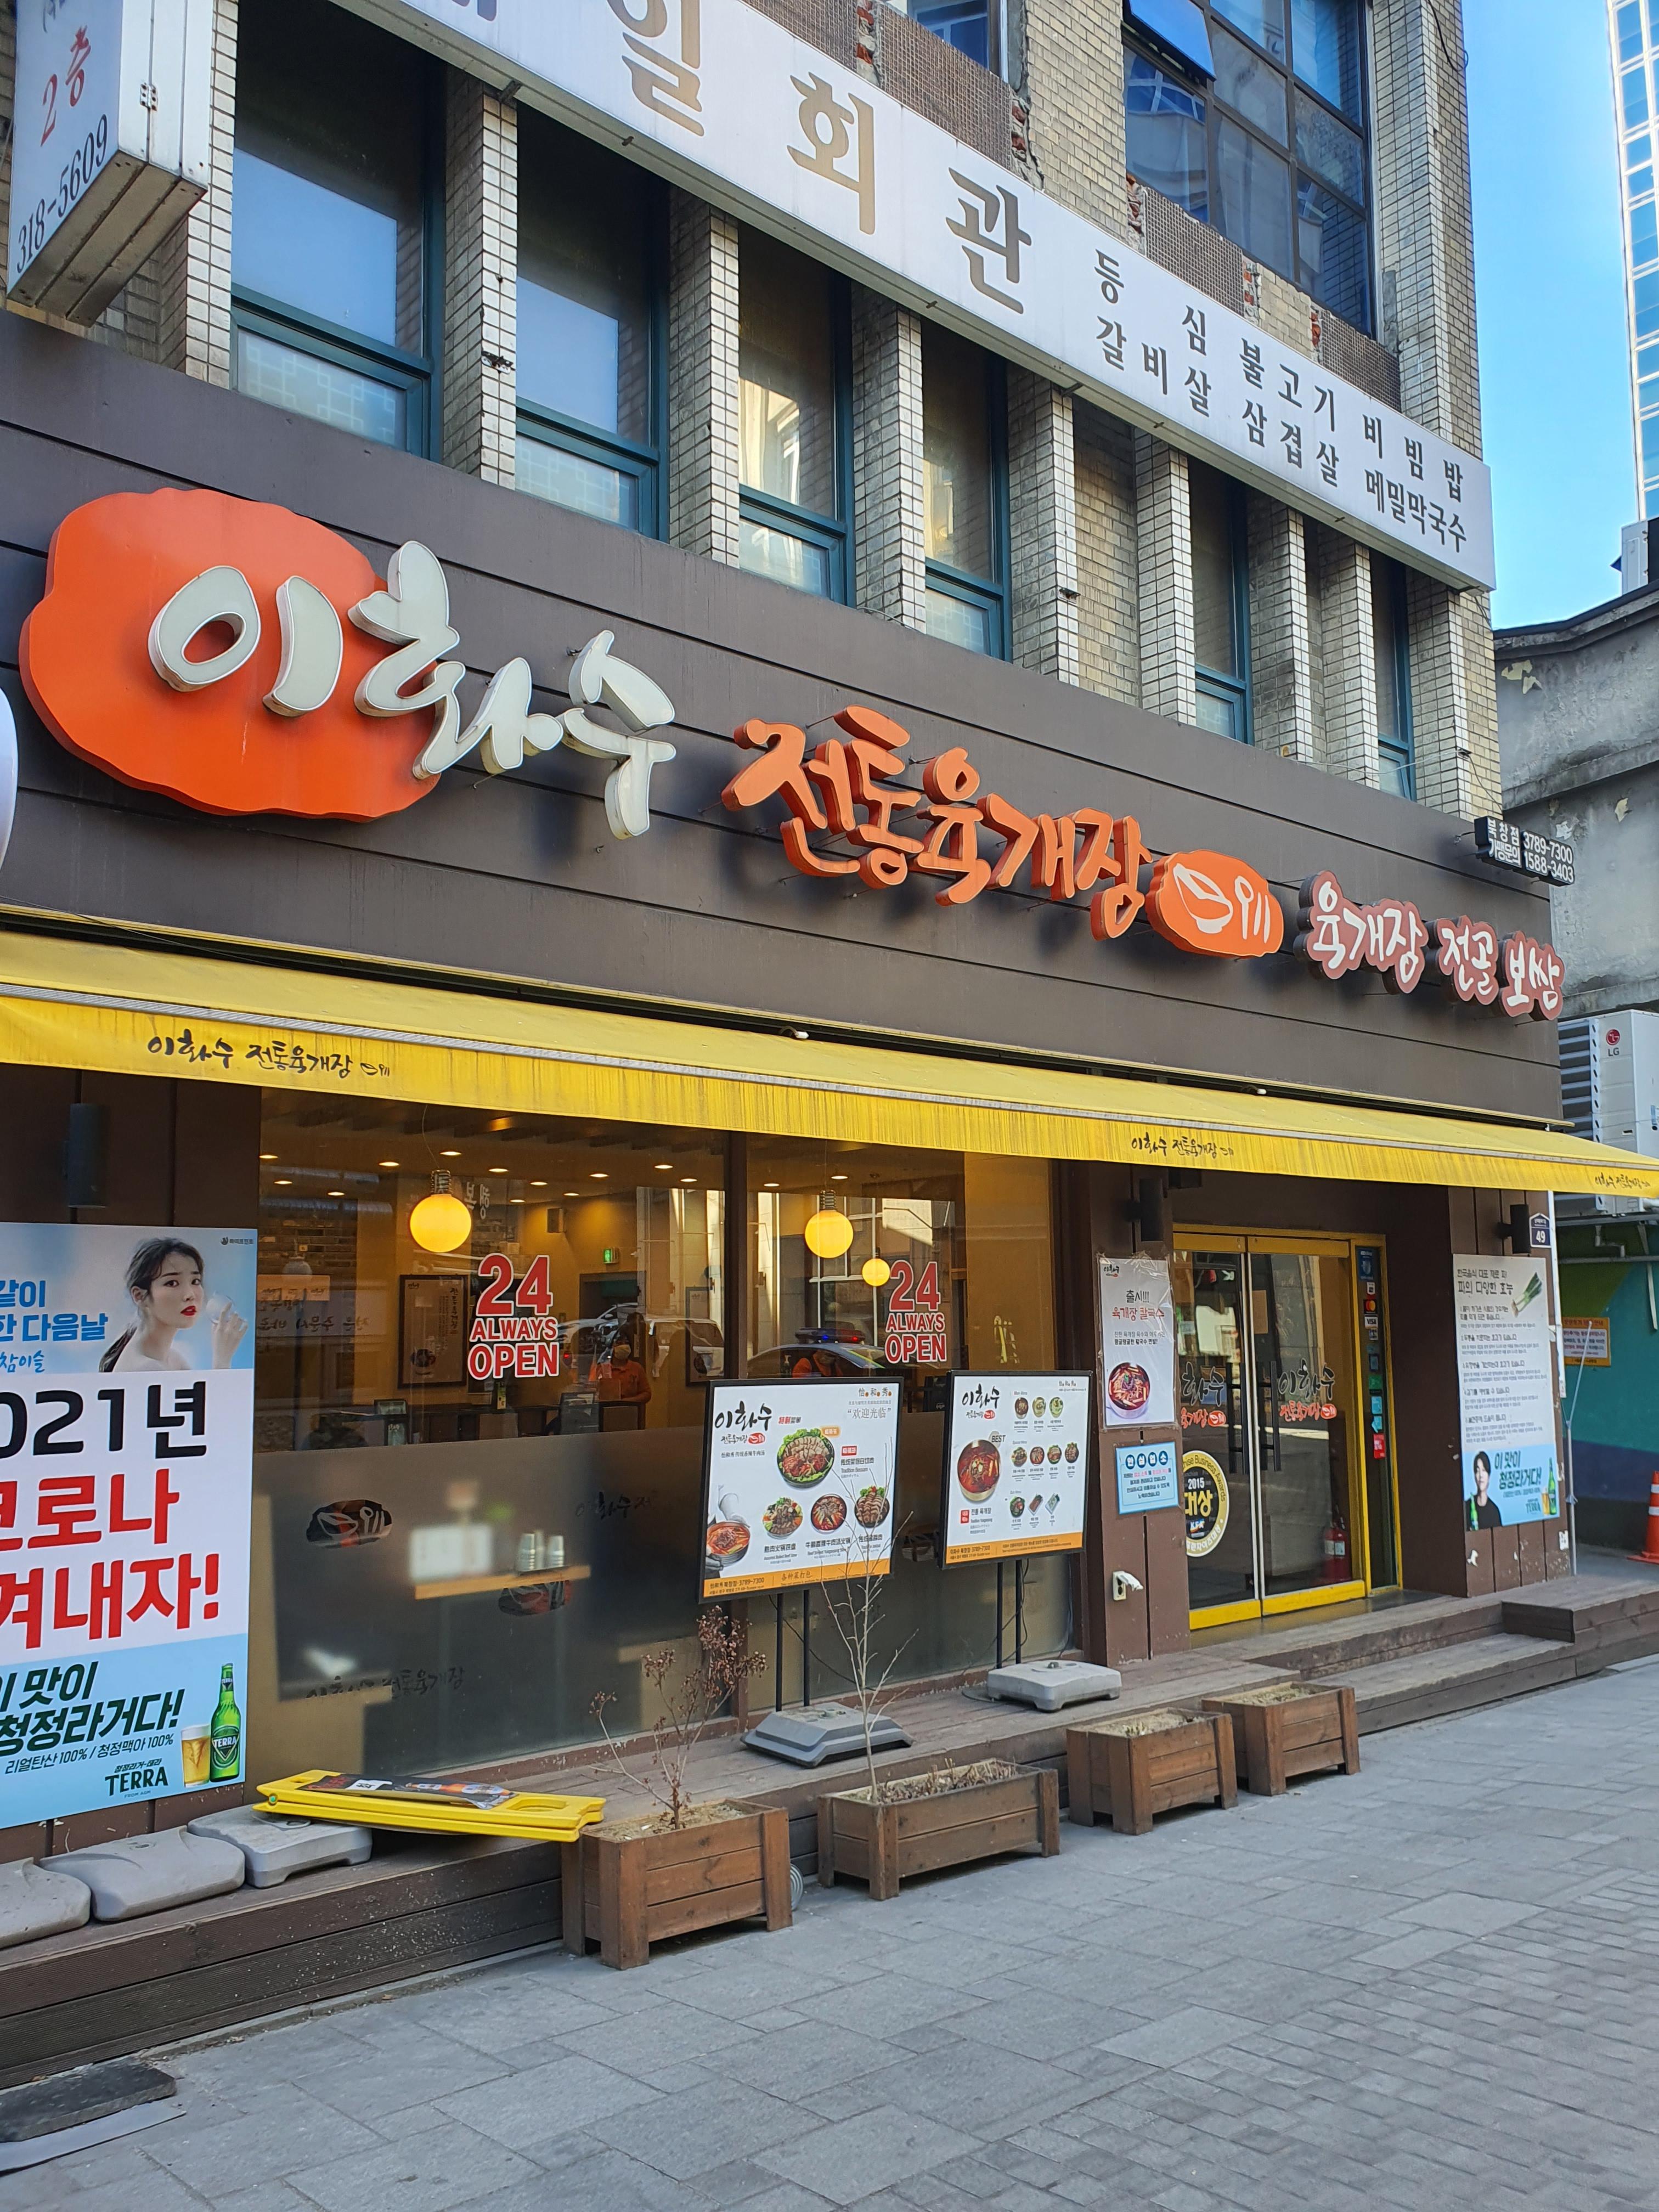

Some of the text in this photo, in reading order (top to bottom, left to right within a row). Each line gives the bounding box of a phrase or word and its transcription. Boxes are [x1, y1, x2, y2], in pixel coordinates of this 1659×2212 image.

[40, 25, 91, 147] 2층
[450, 0, 1031, 314] 일회관
[16, 114, 108, 274] 318-5609
[1096, 316, 1466, 553] 갈비살 삼겹살 메밀막국수
[1239, 338, 1336, 432] 불고기
[1363, 414, 1464, 503] 비빔밥
[148, 540, 1153, 941] 이화수 전통육개장
[1488, 818, 1572, 864] 북창점 3789-7300
[1489, 838, 1573, 882] 가맹문의 1588-3403
[1313, 881, 1423, 983] 육개장
[1442, 925, 1494, 995] 전골
[148, 1029, 353, 1079] 이화수 전통육개장
[1608, 1047, 1620, 1057] LG
[1132, 1132, 1217, 1159] 이화수 전통육개장
[1536, 1231, 1545, 1243] 49
[477, 1252, 554, 1317] 24
[889, 1260, 941, 1312] 24
[1126, 1290, 1149, 1303] 출시!!!
[1458, 1281, 1513, 1295] 파의 다양한 효능
[22, 1313, 108, 1341] 다음날
[470, 1317, 558, 1342] ALWAYS
[885, 1312, 945, 1332] ALWAYS
[1112, 1307, 1164, 1321] 육개장 칼국수
[467, 1343, 560, 1381] OPEN
[884, 1334, 947, 1363] OPEN
[962, 1384, 1000, 1409] 이화수
[1278, 1358, 1335, 1401] 이화수
[715, 1401, 772, 1431] 이화수
[992, 1435, 1006, 1443] BEST
[1494, 1451, 1520, 1469] 이 맛이
[1188, 1477, 1205, 1489] 2015
[1194, 1454, 1216, 1475] Business
[1215, 1473, 1226, 1502] Awards
[1184, 1489, 1213, 1517] 대상
[19, 1661, 99, 1709] 맛이
[0, 1689, 185, 1756] 청정라거다!
[5, 1753, 57, 1774] 리얼탄산
[59, 1747, 88, 1764] 100%
[97, 1737, 145, 1758] 청정맥아
[148, 1733, 174, 1748] 100%
[213, 1736, 236, 1748] TERRA
[105, 1767, 168, 1797] TERRA
